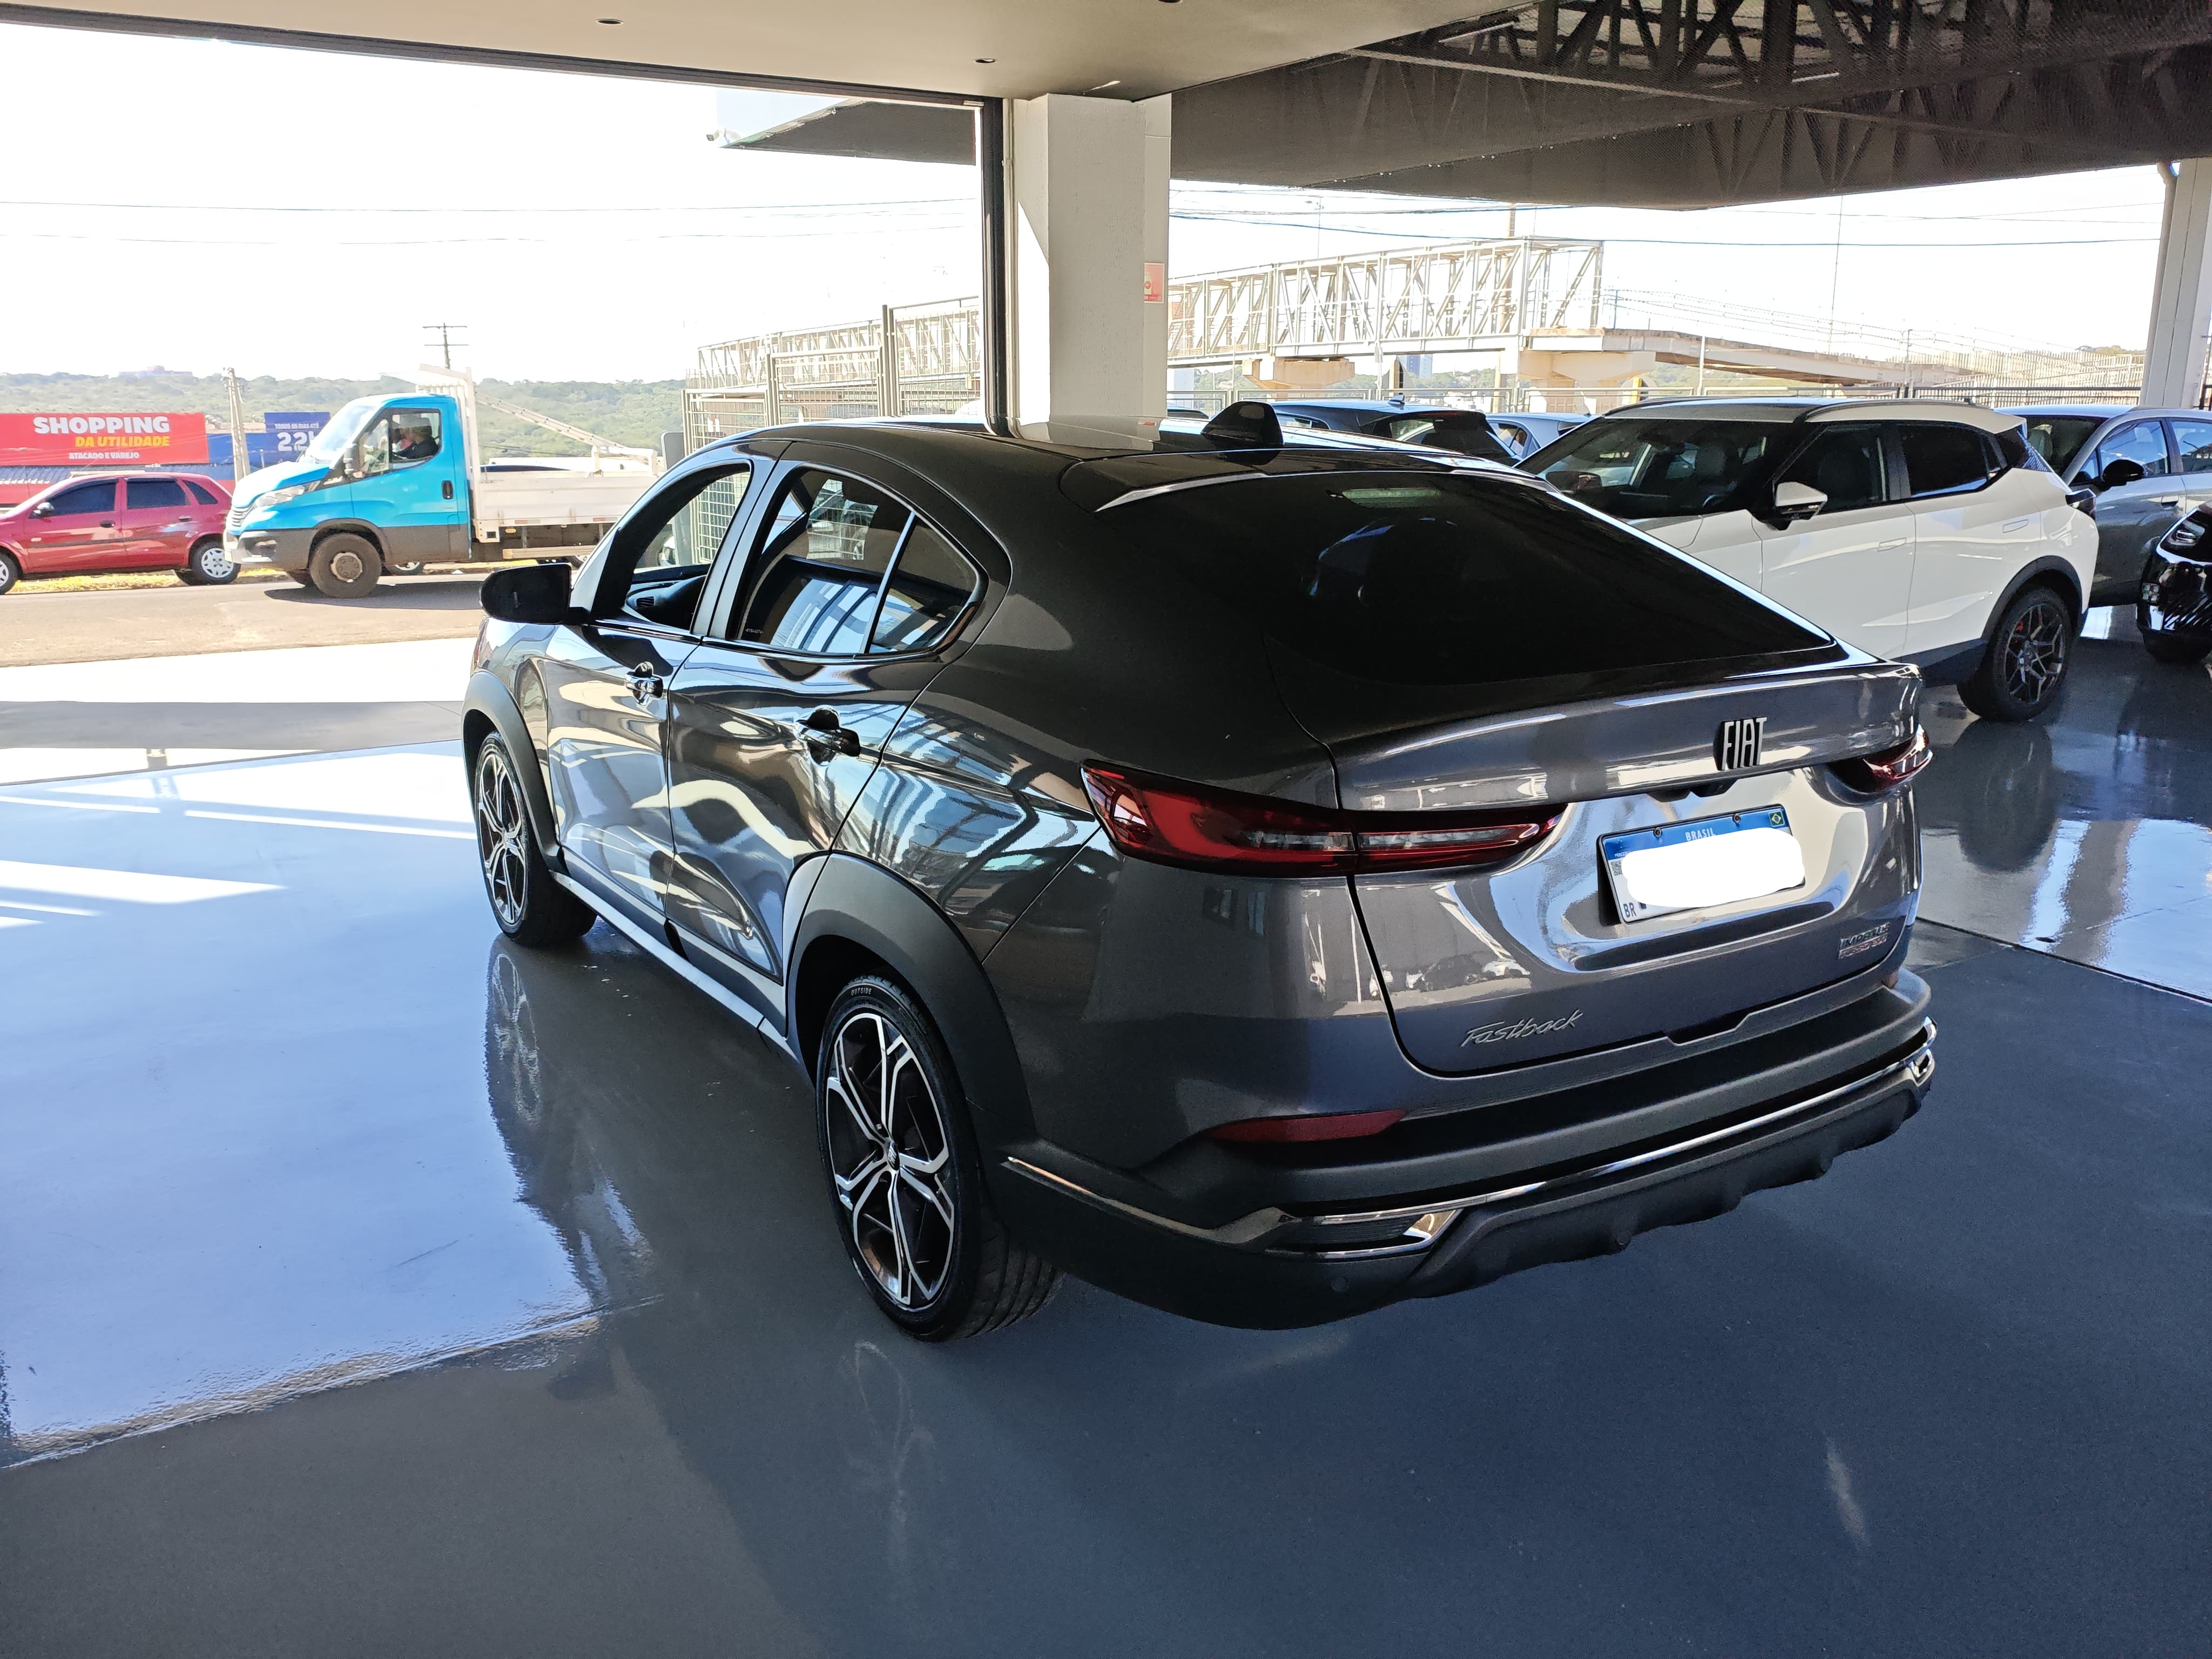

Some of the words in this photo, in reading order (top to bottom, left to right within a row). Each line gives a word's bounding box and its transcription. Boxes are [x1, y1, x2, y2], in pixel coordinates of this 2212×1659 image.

[33, 416, 170, 434] SHOPPING
[75, 436, 96, 447] DA
[97, 436, 170, 447] UTILIDADE
[1721, 717, 1768, 771] FIAT
[1685, 827, 1716, 841] BRASIL
[1623, 902, 1637, 918] BR
[851, 987, 872, 996] OUTSIDE
[1460, 1009, 1583, 1048] Fastback
